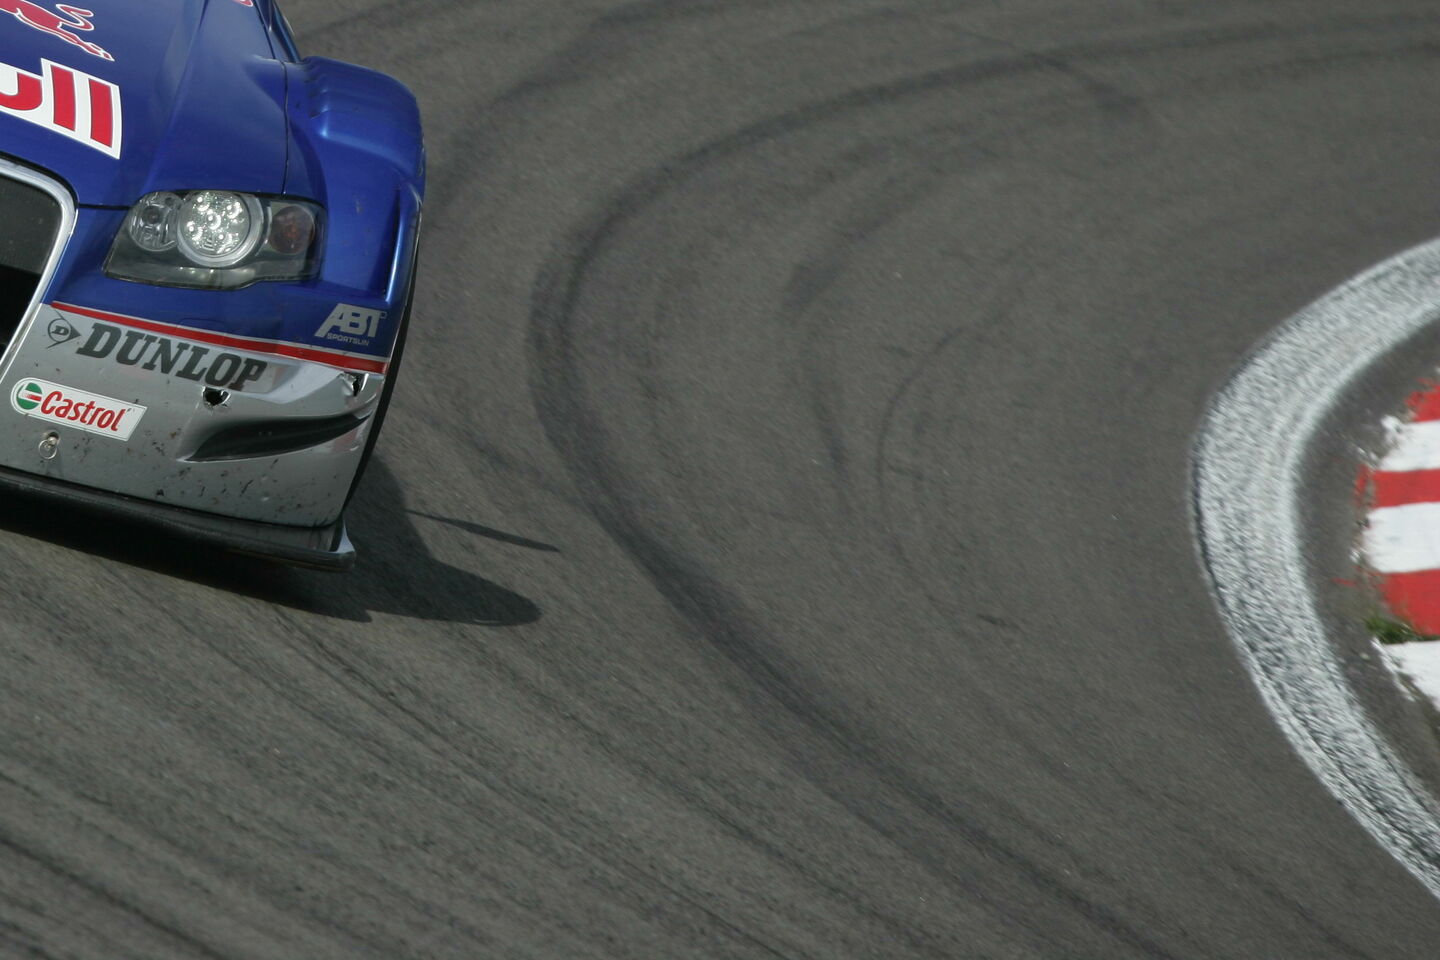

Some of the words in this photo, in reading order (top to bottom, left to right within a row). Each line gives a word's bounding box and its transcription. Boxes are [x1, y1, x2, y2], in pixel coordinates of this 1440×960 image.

[313, 303, 381, 338] ABT
[76, 322, 268, 392] DUNLOP
[40, 390, 127, 432] Castrol
